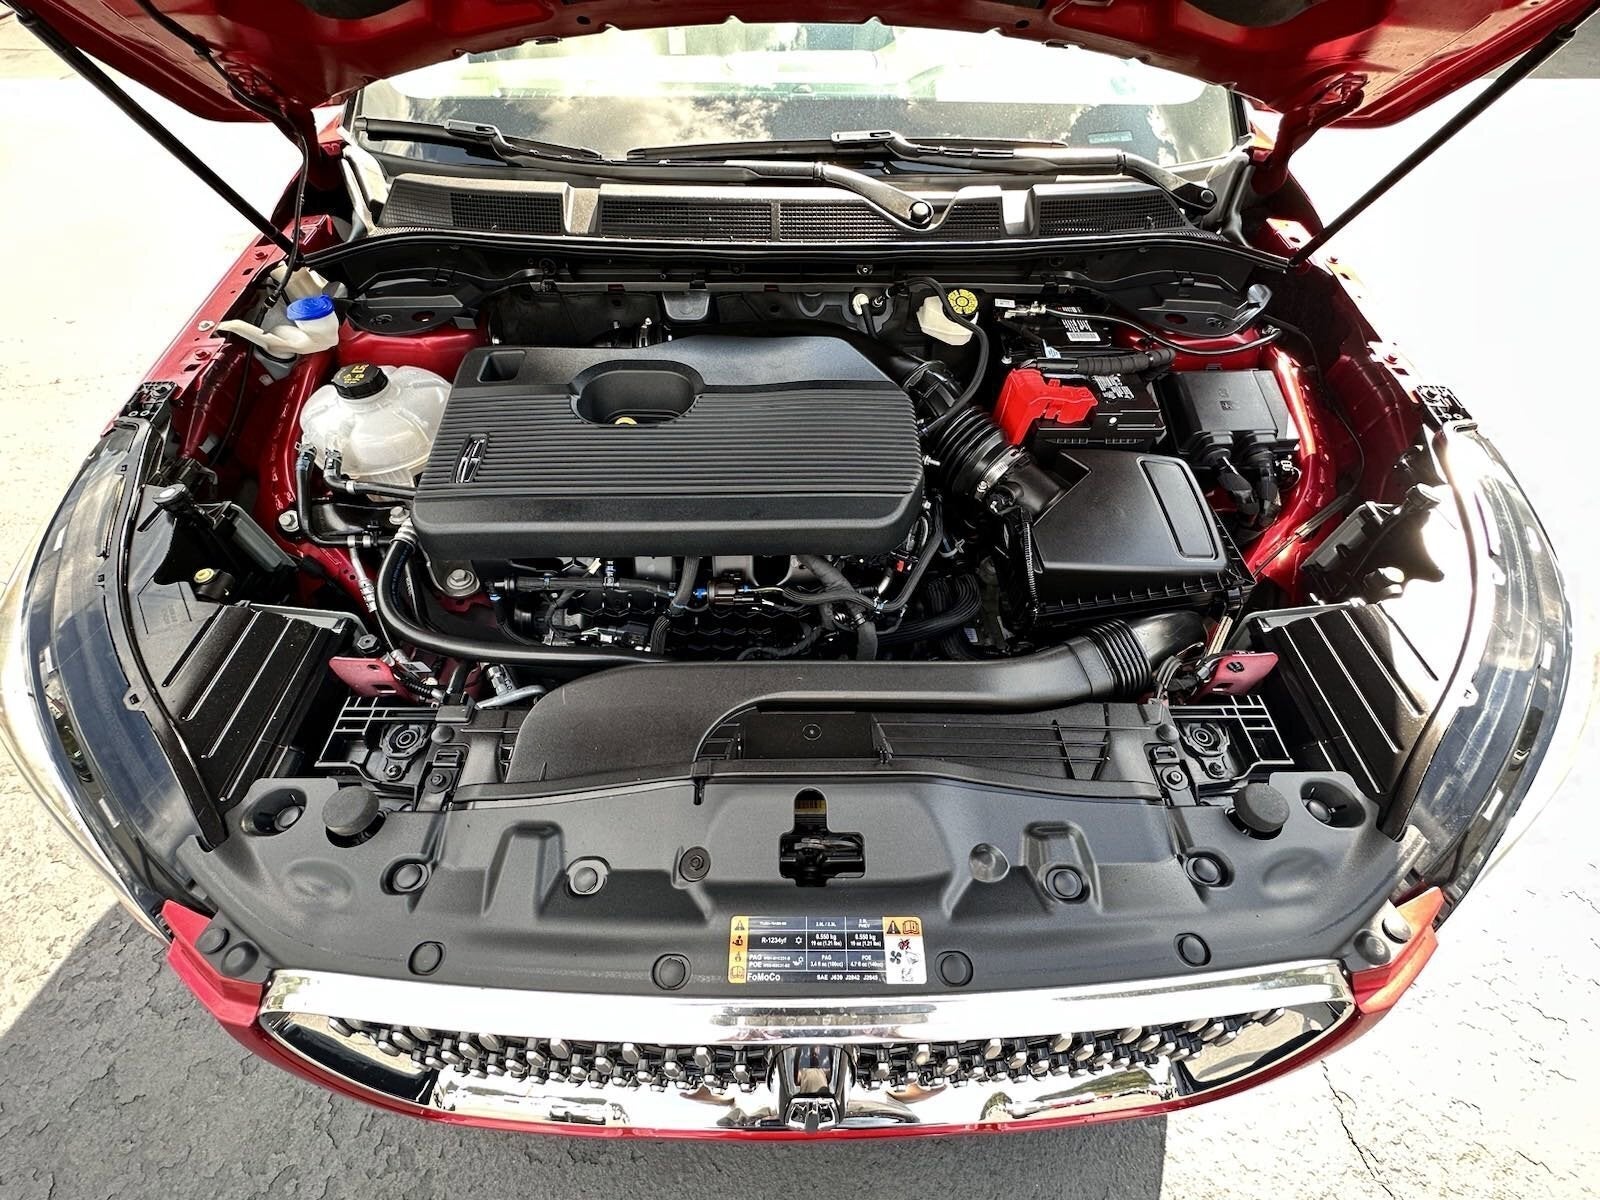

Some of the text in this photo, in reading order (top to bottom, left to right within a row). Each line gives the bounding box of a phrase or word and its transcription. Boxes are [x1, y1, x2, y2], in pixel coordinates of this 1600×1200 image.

[761, 936, 787, 944] R-1234yf
[830, 933, 837, 942] kg
[869, 933, 877, 942] kg
[747, 972, 781, 981] FoMoCo
